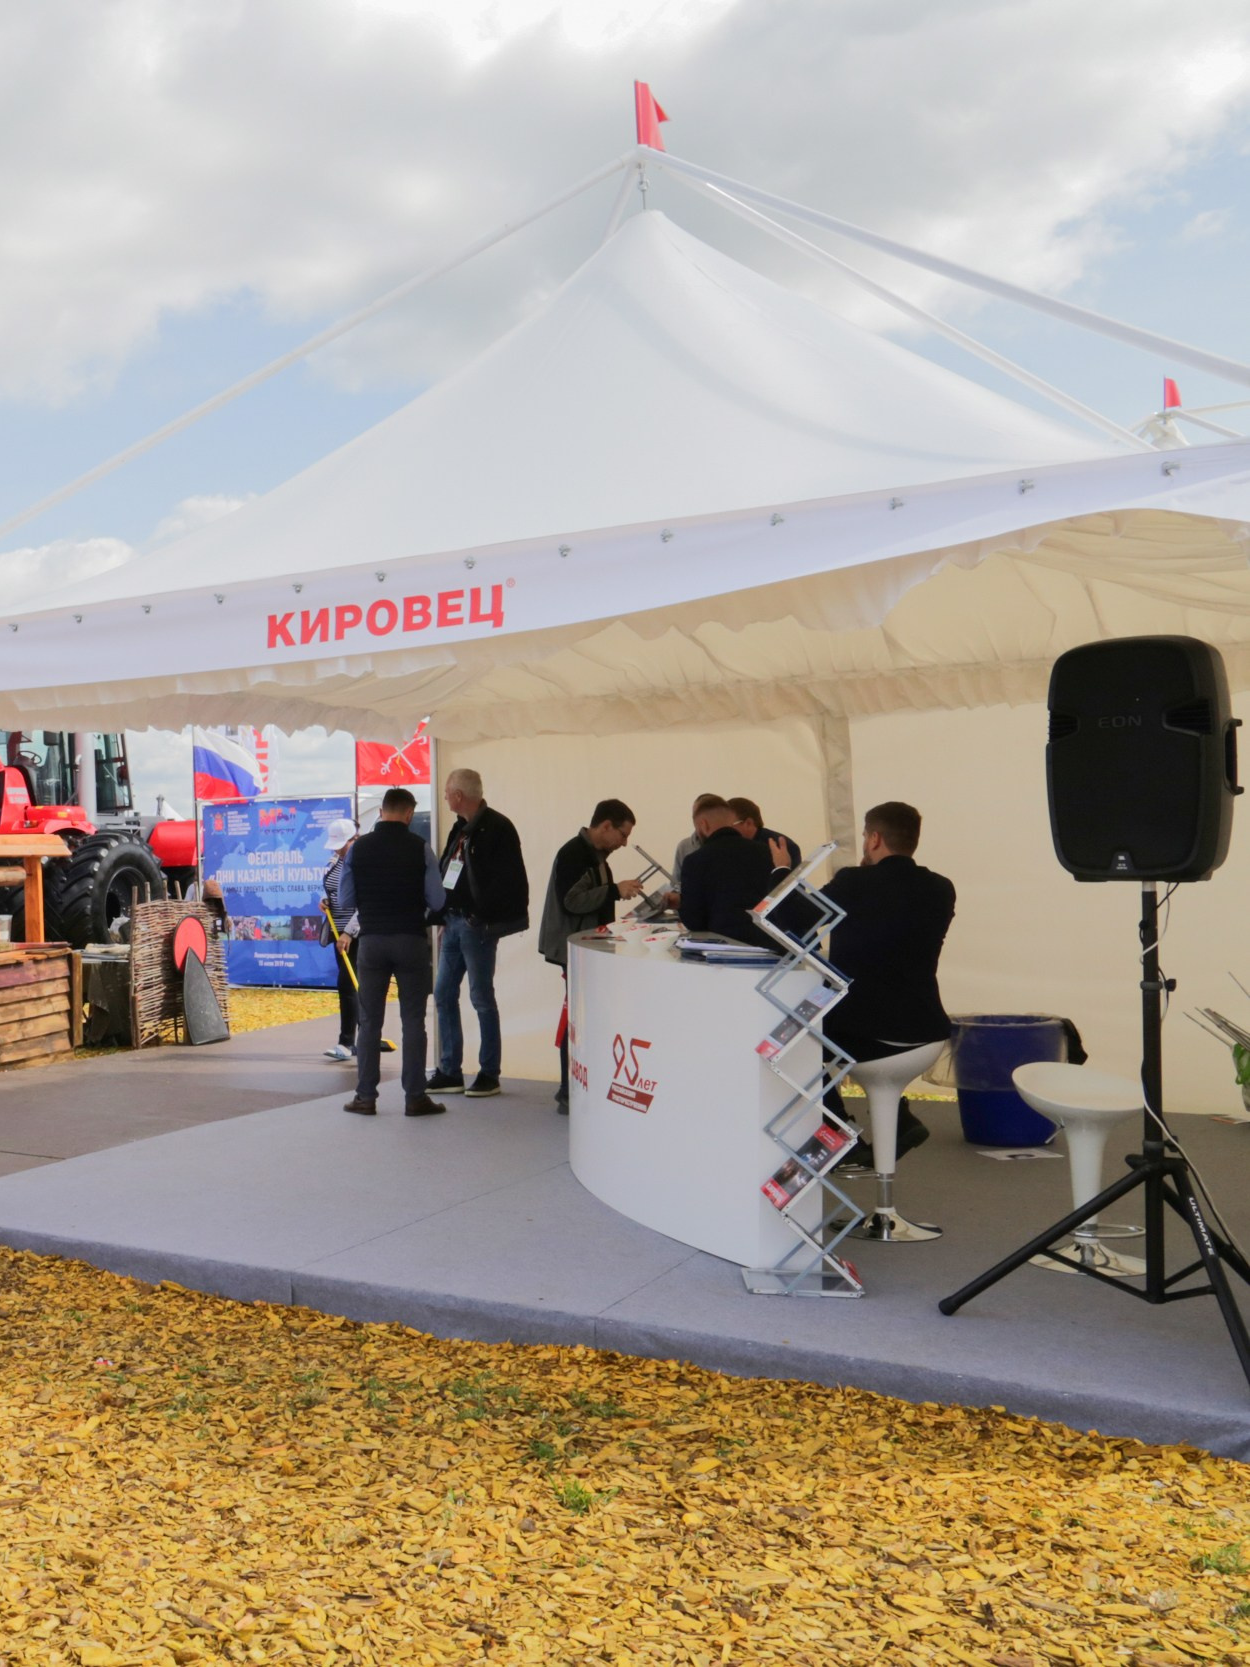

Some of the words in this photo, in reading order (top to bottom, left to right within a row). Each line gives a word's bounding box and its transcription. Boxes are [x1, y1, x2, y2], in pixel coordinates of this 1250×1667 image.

[267, 584, 505, 649] КИРОВЕЦ
[1098, 714, 1142, 729] EON
[237, 865, 285, 883] КАЗАЧЬЕЙ
[247, 850, 304, 865] ФЕСТИВАЛЬ
[612, 1033, 652, 1086] 95
[1189, 1197, 1215, 1255] ULTIMATE
